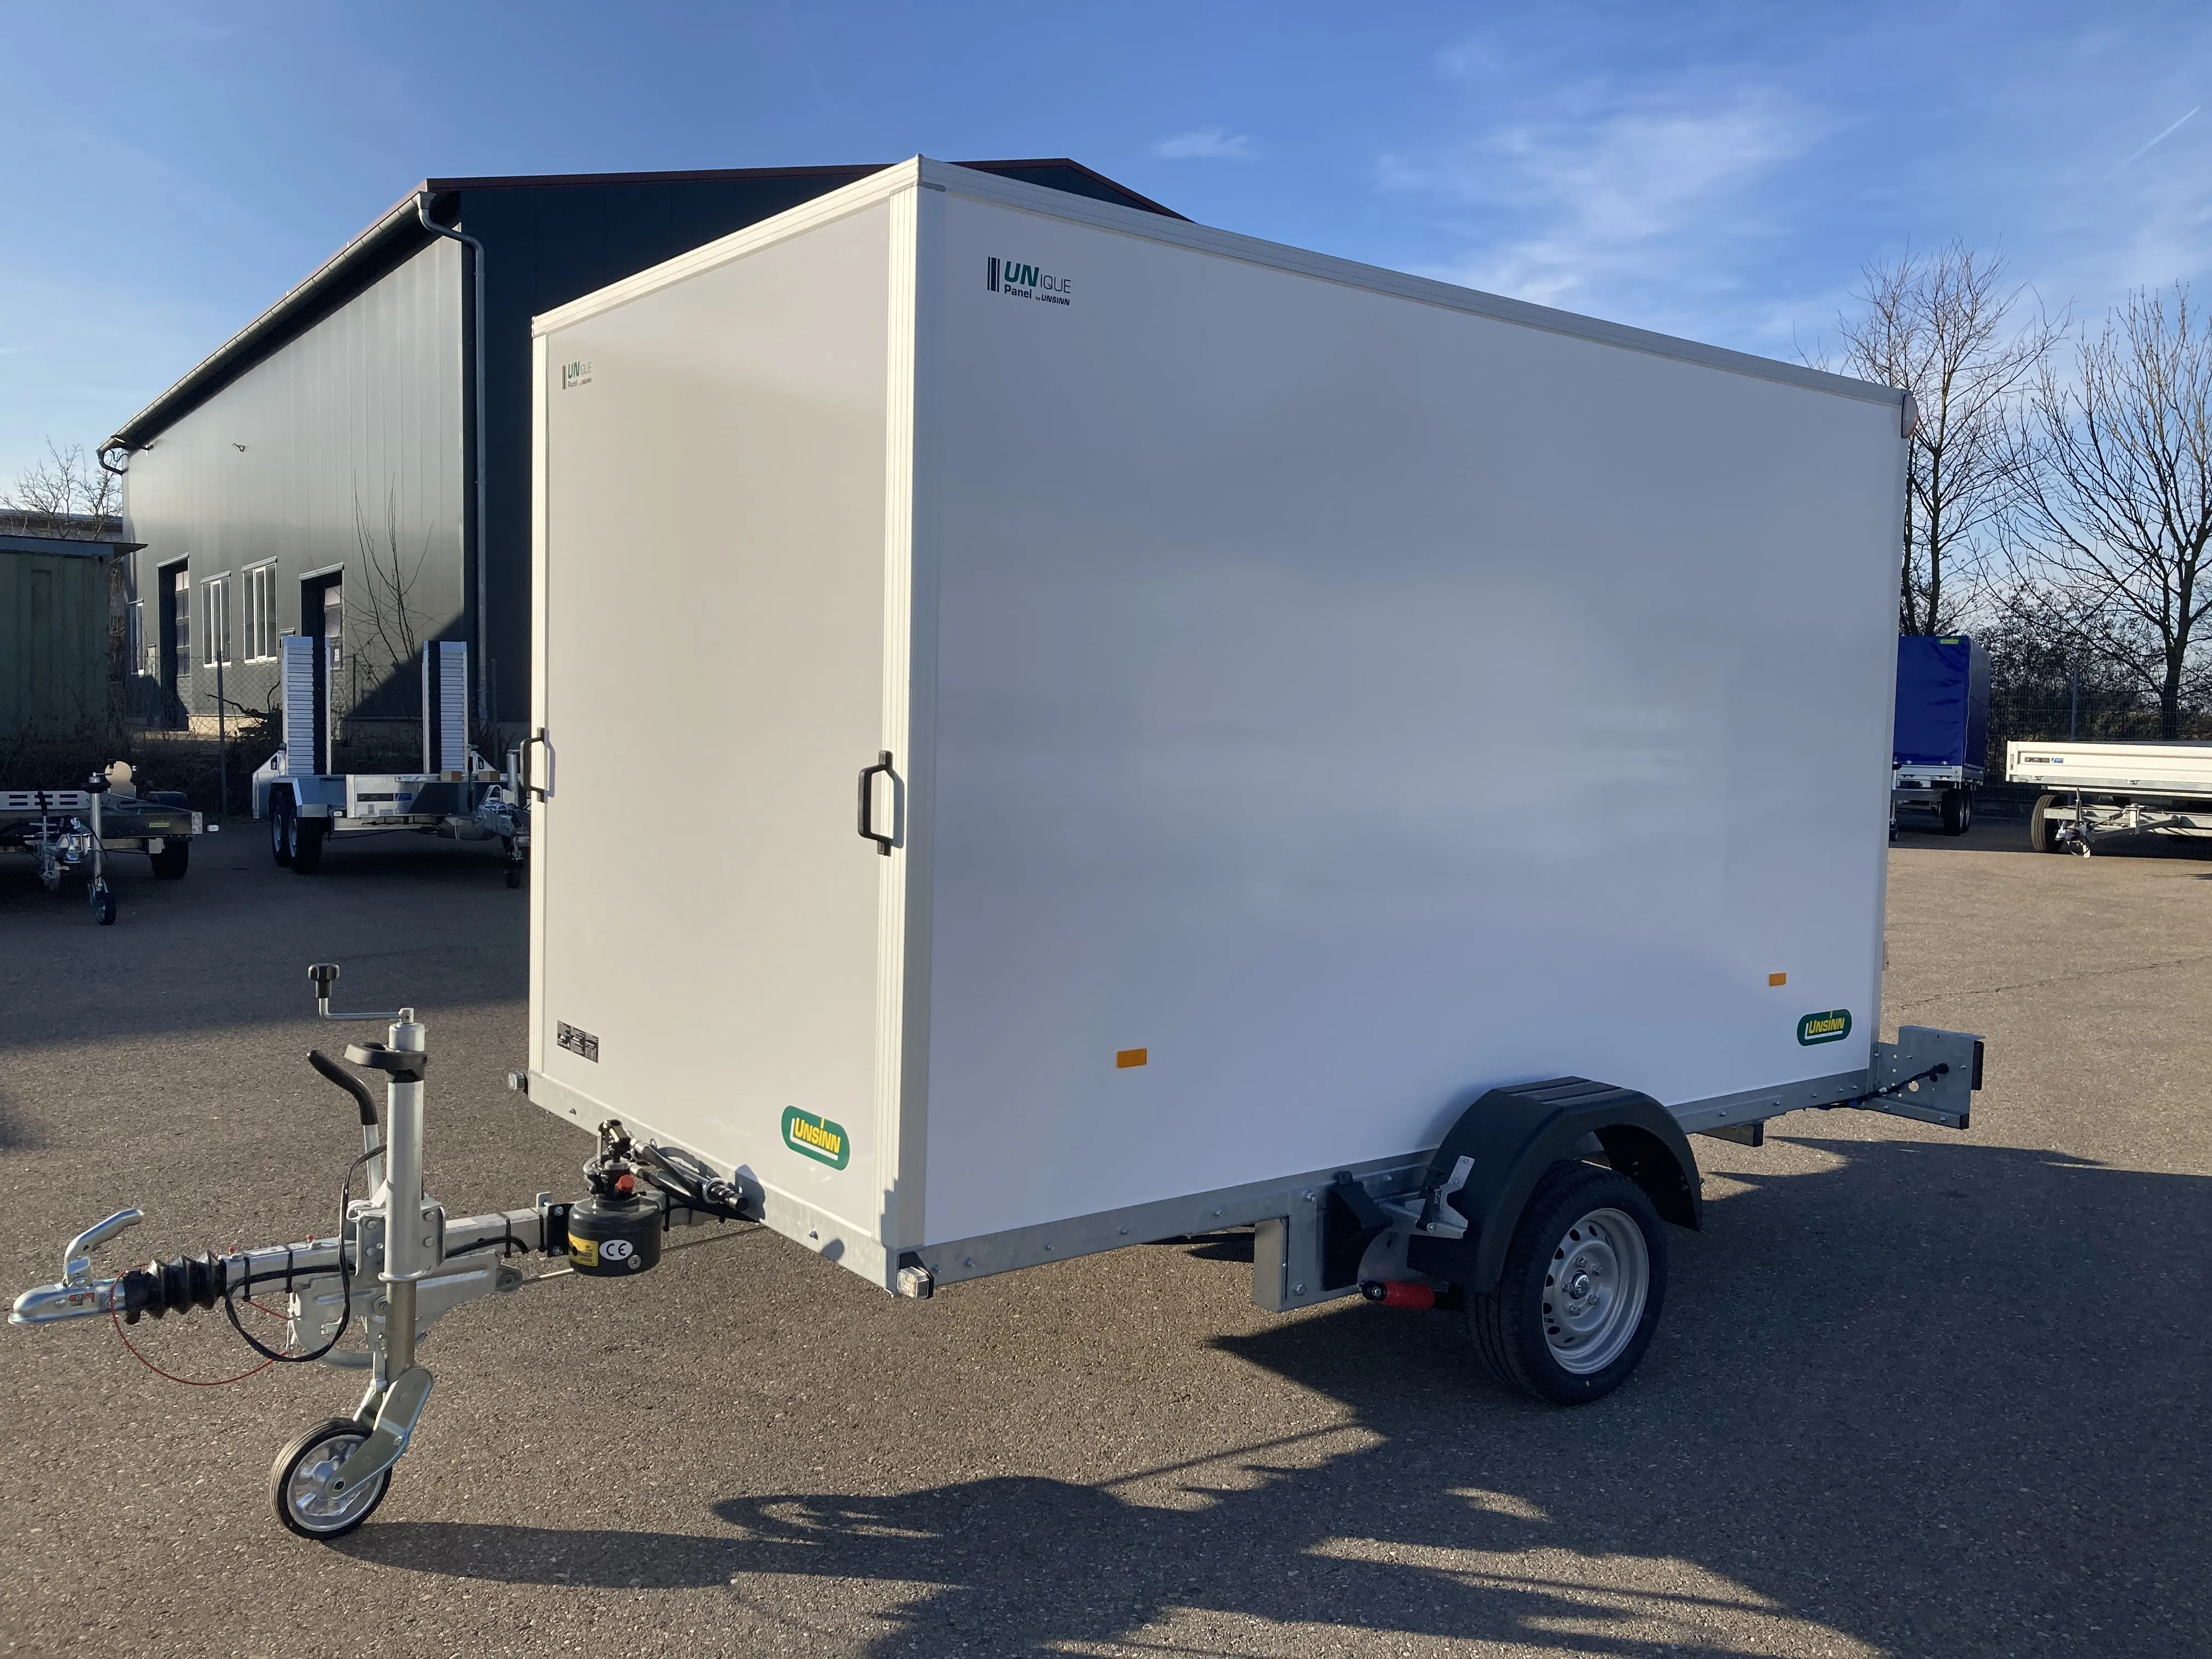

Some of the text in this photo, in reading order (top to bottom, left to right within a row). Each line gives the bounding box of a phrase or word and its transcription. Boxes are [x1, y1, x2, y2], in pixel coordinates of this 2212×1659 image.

[1005, 284, 1032, 299] Panel
[1041, 294, 1070, 306] UNSINN
[1808, 1017, 1845, 1034] UNSINN
[794, 1117, 841, 1153] UNSINN
